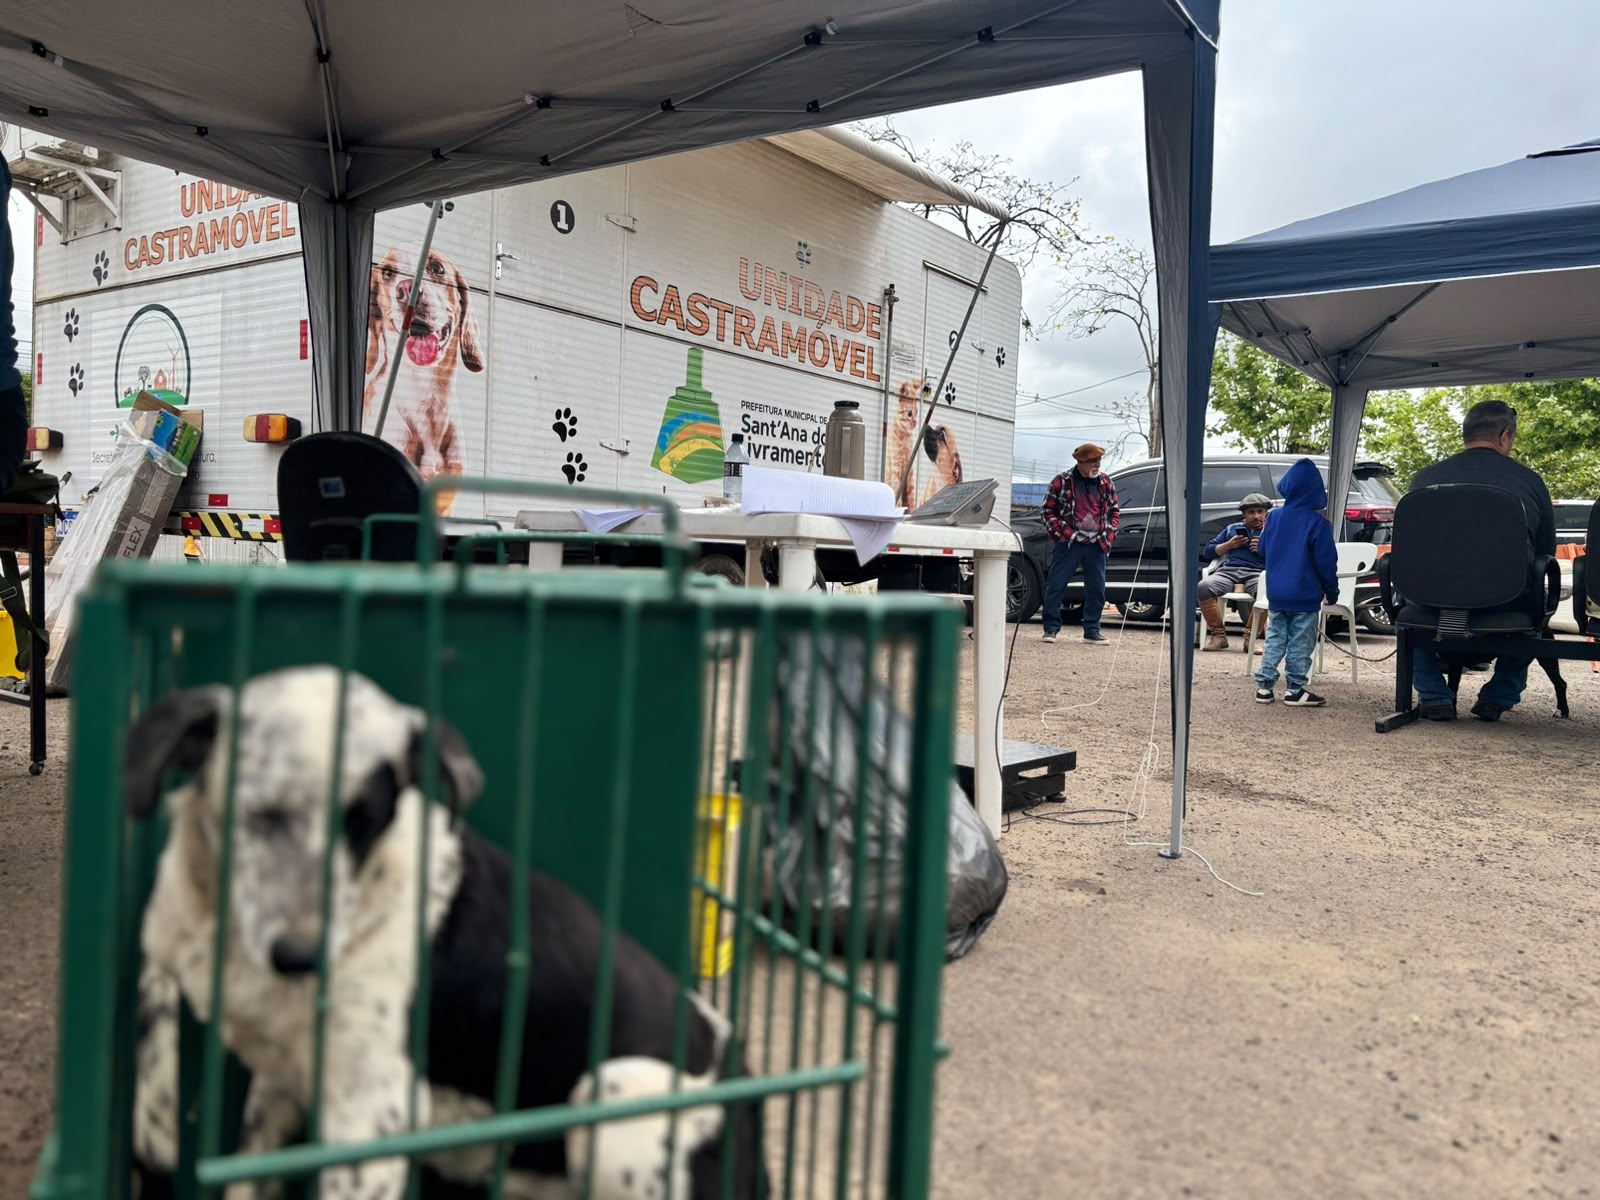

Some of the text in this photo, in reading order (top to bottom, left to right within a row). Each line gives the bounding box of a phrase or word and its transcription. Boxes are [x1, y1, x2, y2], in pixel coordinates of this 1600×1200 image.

[124, 200, 295, 270] CASTRAMÓVEL
[738, 256, 881, 340] UNIDADE
[630, 275, 881, 382] CASTRAMÓVEL
[740, 400, 828, 425] PREFEITURA MUNICIPAL DE
[741, 413, 808, 443] Sant'Ana
[747, 435, 827, 468] ivrament
